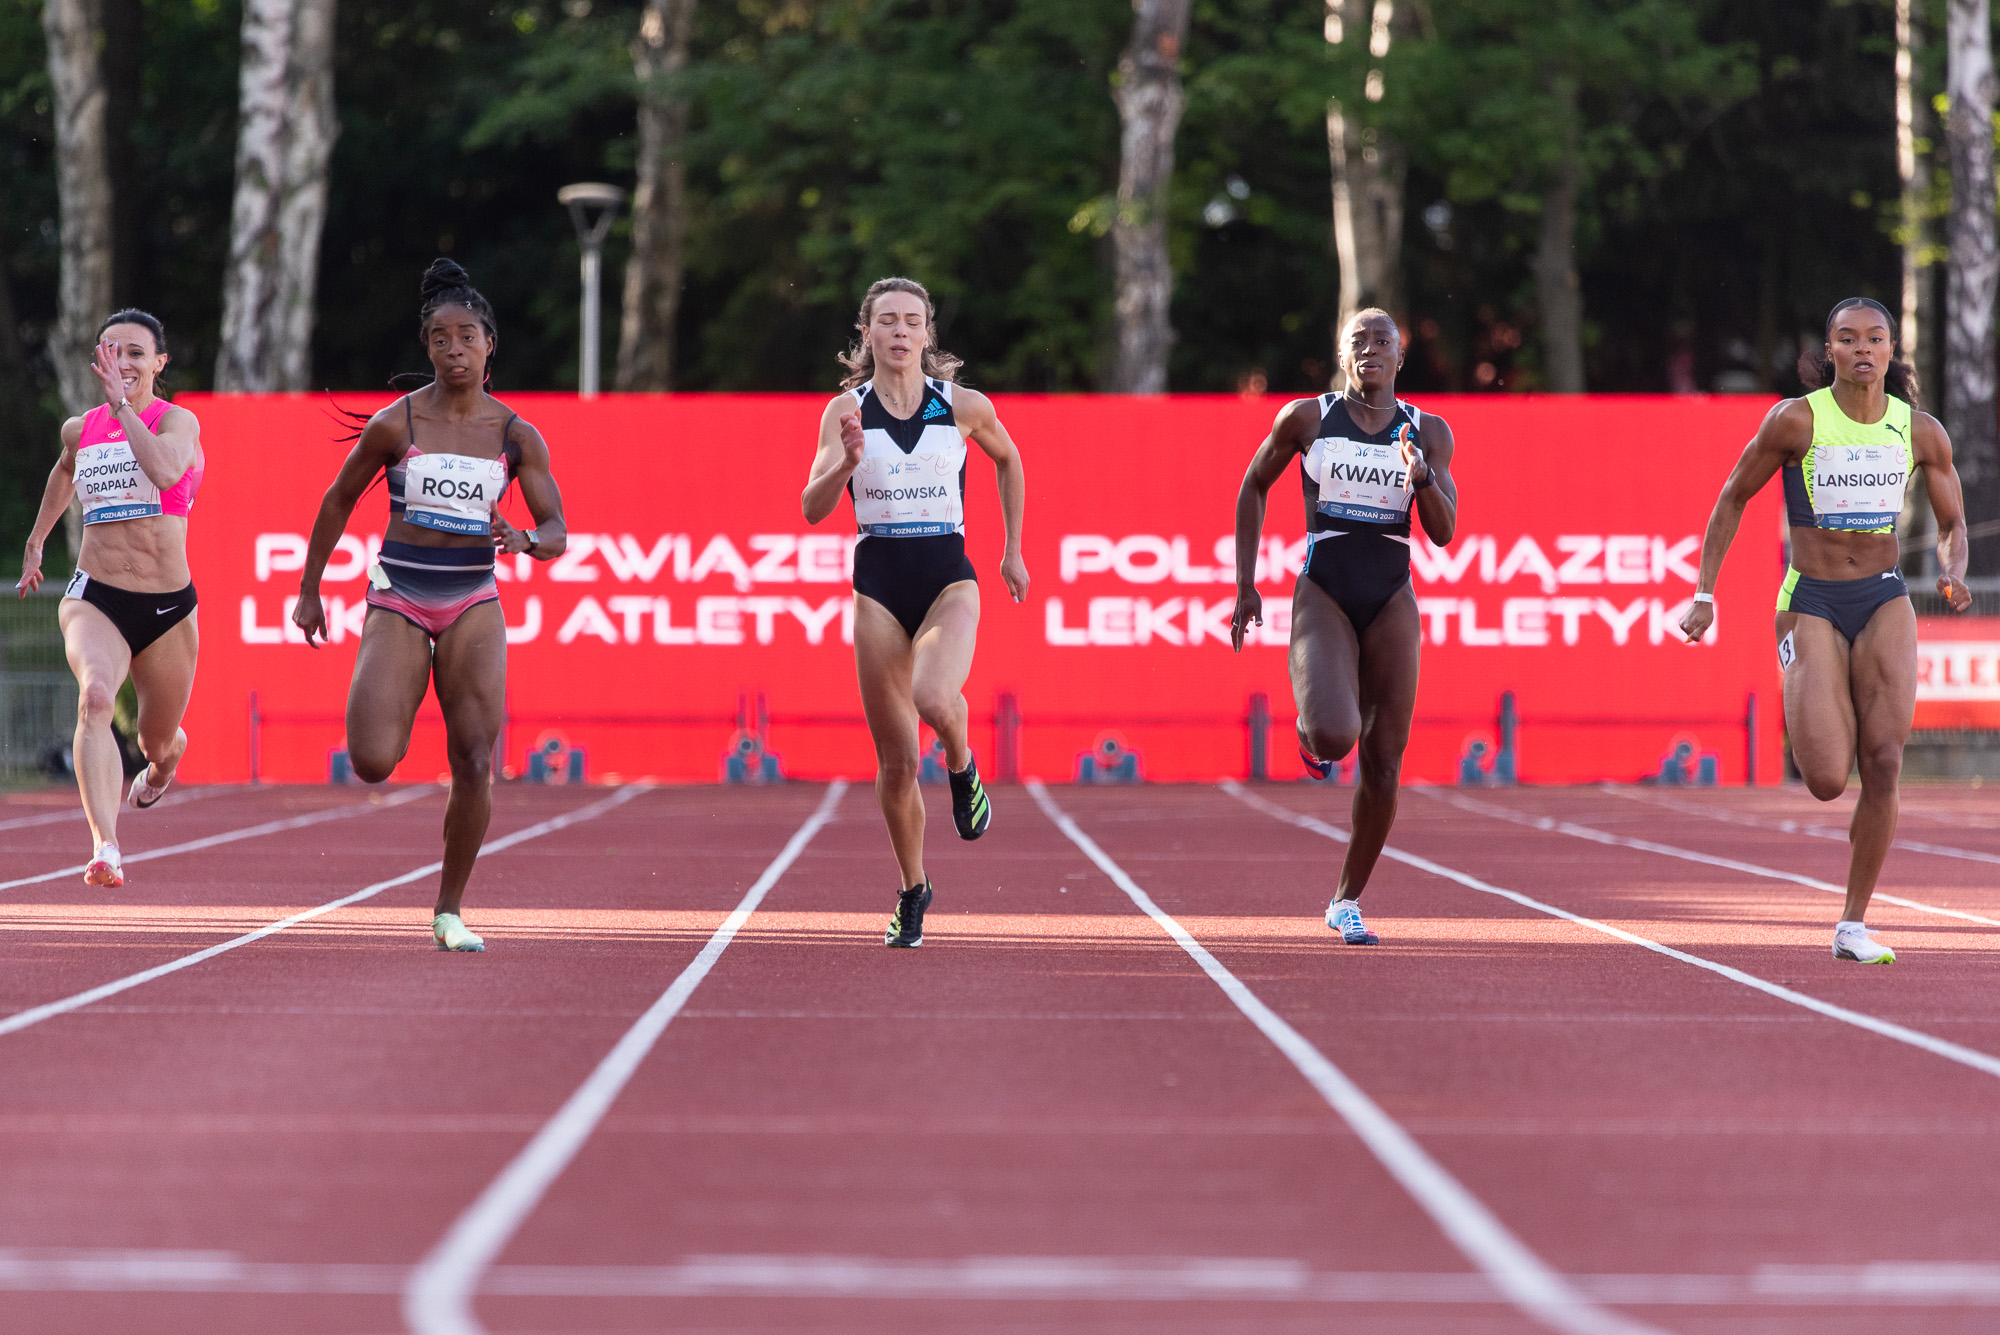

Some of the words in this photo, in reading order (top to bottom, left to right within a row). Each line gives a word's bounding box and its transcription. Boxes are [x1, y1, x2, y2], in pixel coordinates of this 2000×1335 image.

[922, 408, 947, 420] adidas
[1330, 462, 1408, 488] KWAYE
[1817, 471, 1905, 487] LANSIQUOT
[86, 477, 138, 495] DRAPAŁA
[421, 477, 484, 501] ROSA
[865, 485, 948, 501] HOROWSKA
[100, 509, 128, 520] POZNAŃ
[128, 507, 147, 516] 2022
[1346, 508, 1379, 520] POZNAŃ
[1846, 516, 1879, 525] POZNAŃ
[1879, 515, 1893, 524] 2022
[433, 518, 467, 531] POZNAŃ
[891, 525, 922, 535] POZNAŃ
[922, 525, 941, 533] 2022
[548, 532, 854, 592] ZWIĄZE
[1060, 533, 1306, 584] POLSK
[1410, 533, 1701, 594] WIĄZEK
[556, 594, 854, 645] ATLETY
[1782, 639, 1792, 666] 3
[1917, 654, 2000, 687] RLE
